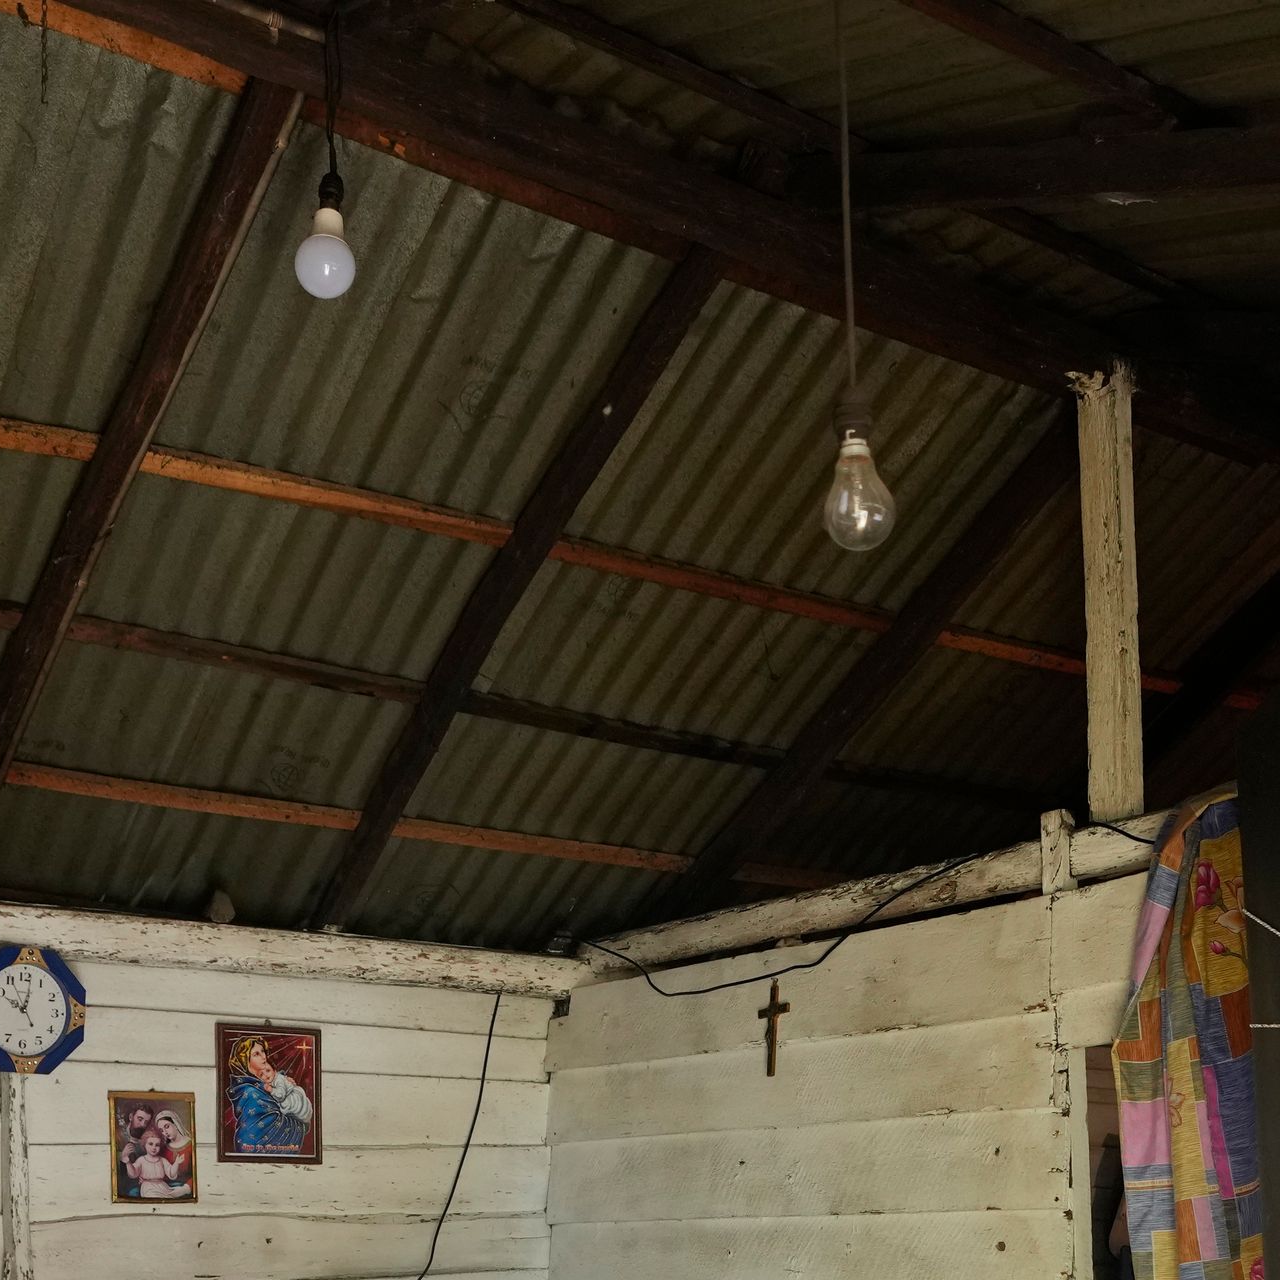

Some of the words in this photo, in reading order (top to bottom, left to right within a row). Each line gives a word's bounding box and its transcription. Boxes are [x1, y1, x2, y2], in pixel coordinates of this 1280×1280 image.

[6, 975, 15, 986] 11
[19, 971, 32, 983] 12
[47, 992, 56, 1002] 2
[50, 1009, 59, 1019] 3
[46, 1025, 55, 1034] 4
[4, 1033, 13, 1043] 7
[34, 1035, 43, 1046] 5
[18, 1039, 27, 1050] 6
